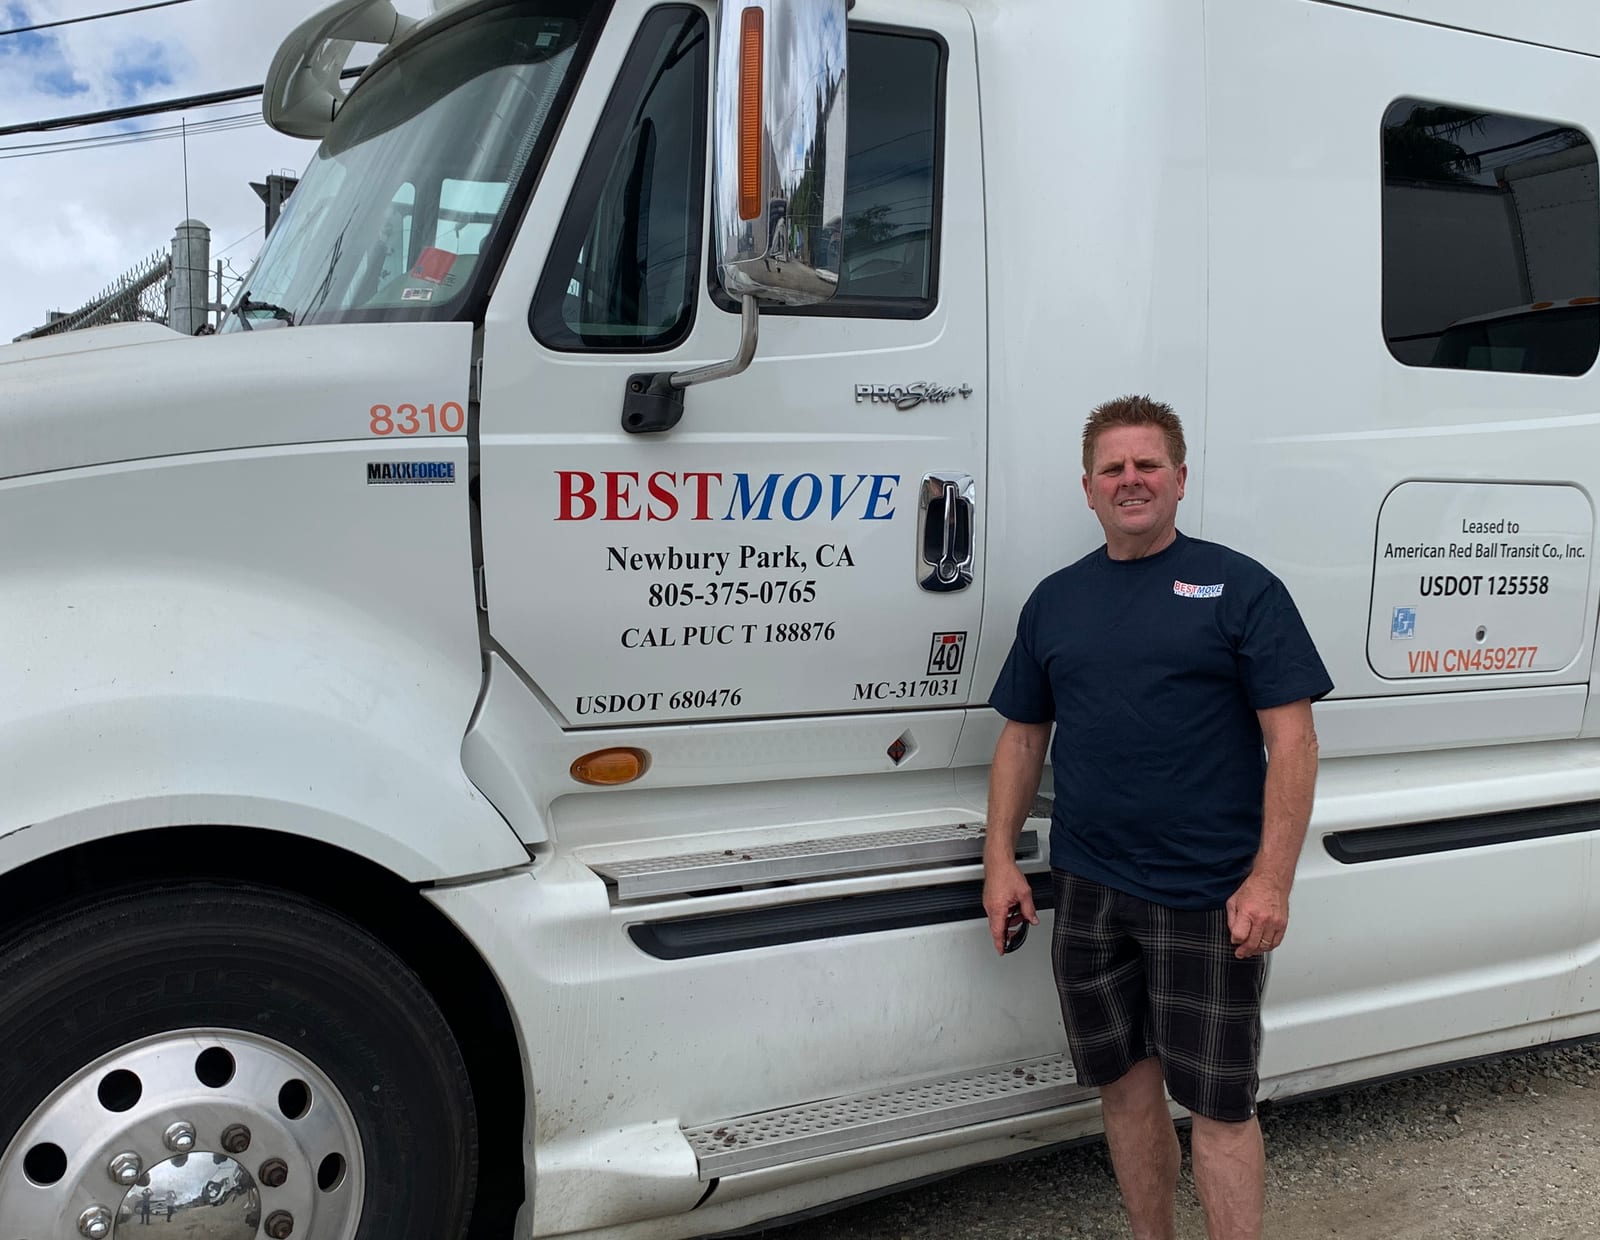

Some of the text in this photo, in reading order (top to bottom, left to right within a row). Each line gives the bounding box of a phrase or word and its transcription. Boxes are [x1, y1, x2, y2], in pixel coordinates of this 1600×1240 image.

[369, 401, 465, 435] 8310
[367, 462, 455, 480] MAXXFORCE
[1462, 518, 1520, 534] Leased to
[606, 543, 856, 576] Newbury Park, CA
[1384, 543, 1586, 560] American Red Ball Transit Co., Inc.
[648, 580, 817, 608] 805-375-0765
[1420, 575, 1549, 596] USDOT 125558
[621, 621, 836, 649] CAL PUC T 188876
[932, 643, 960, 672] 40
[1408, 646, 1538, 673] VIN CN459277
[576, 687, 743, 715] USDOT 680476
[853, 679, 958, 702] MC-317031
